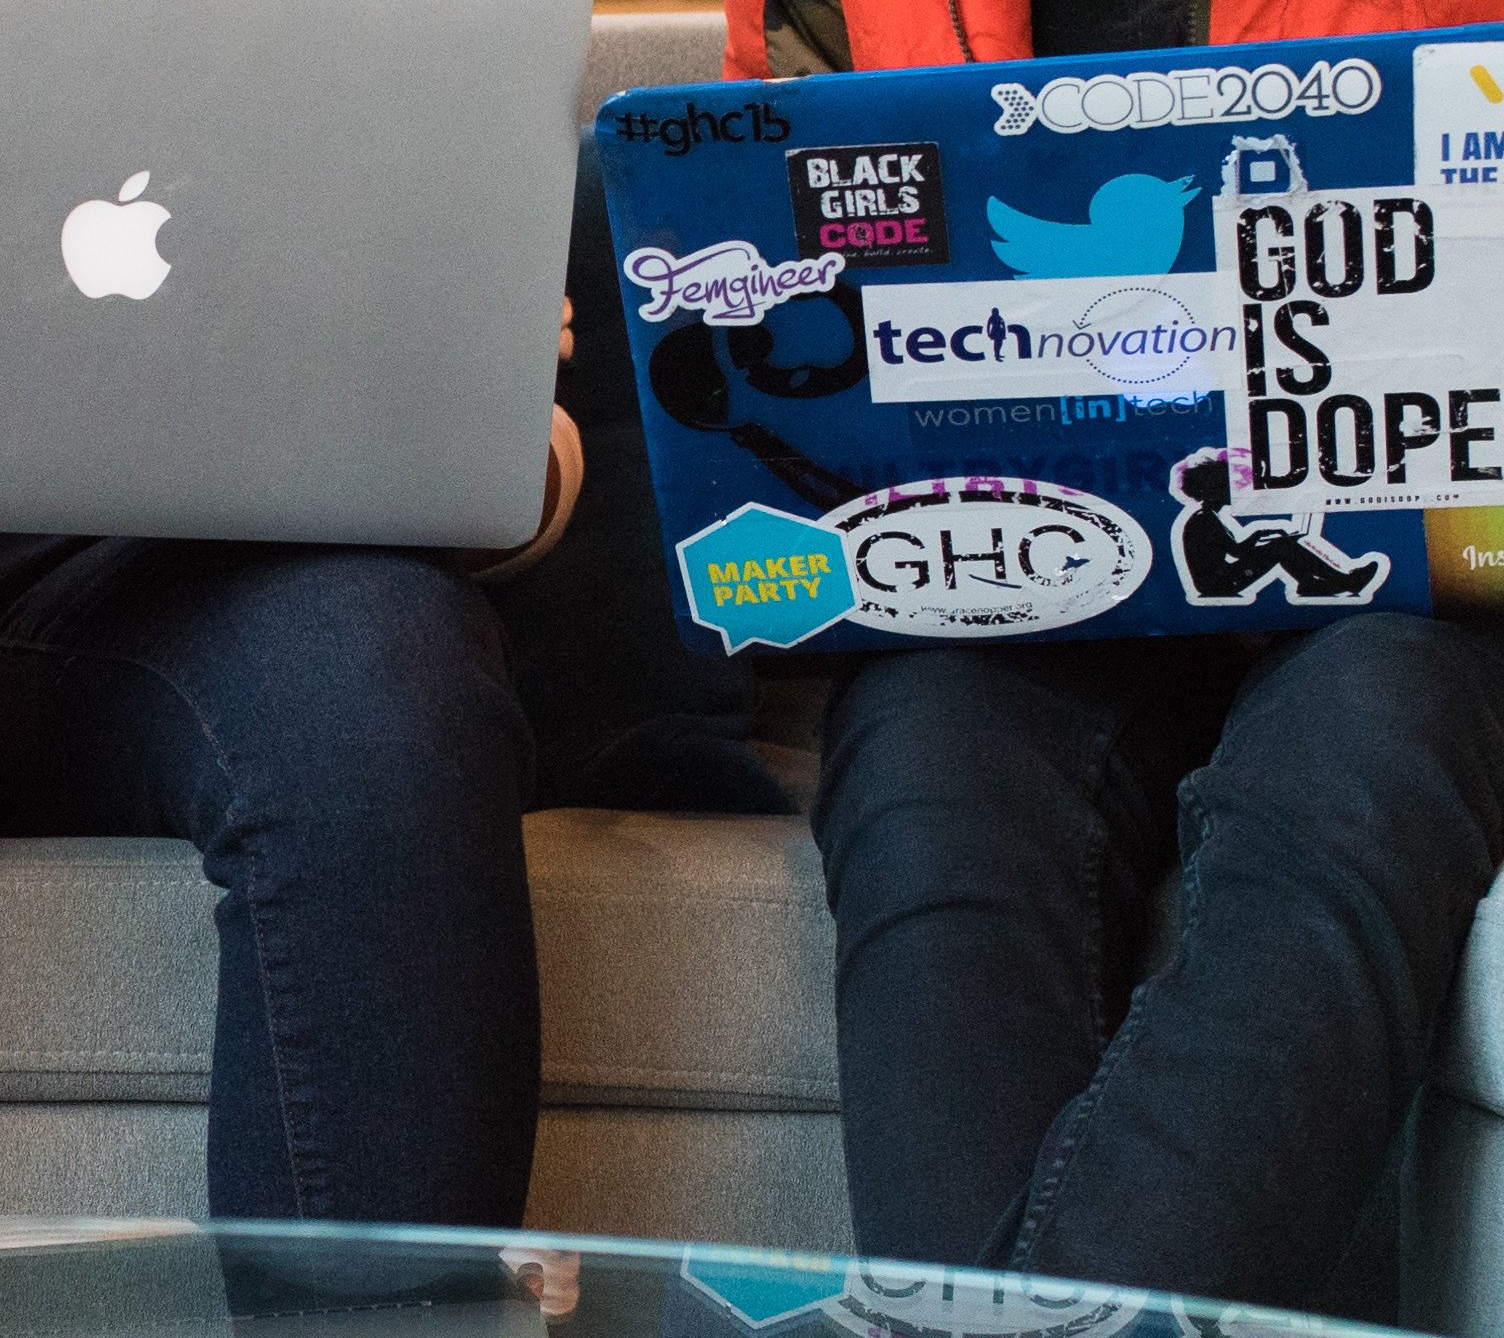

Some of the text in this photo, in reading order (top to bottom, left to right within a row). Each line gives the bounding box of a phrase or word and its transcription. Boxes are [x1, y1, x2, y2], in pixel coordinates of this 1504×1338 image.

[1041, 65, 1375, 128] CODE2040
[615, 101, 790, 157] #ghc15
[1441, 133, 1450, 161] I
[806, 154, 925, 188] BLACK
[1441, 167, 1498, 184] THE
[820, 186, 921, 219] GIRLS
[819, 218, 929, 249] CODE
[1237, 197, 1436, 302] GOD
[629, 245, 839, 322] Femgineer
[872, 307, 1238, 365] technovation
[1243, 300, 1332, 397] IS
[707, 553, 832, 585] MAKER
[856, 524, 1087, 594] GHC
[713, 577, 821, 607] PARTY
